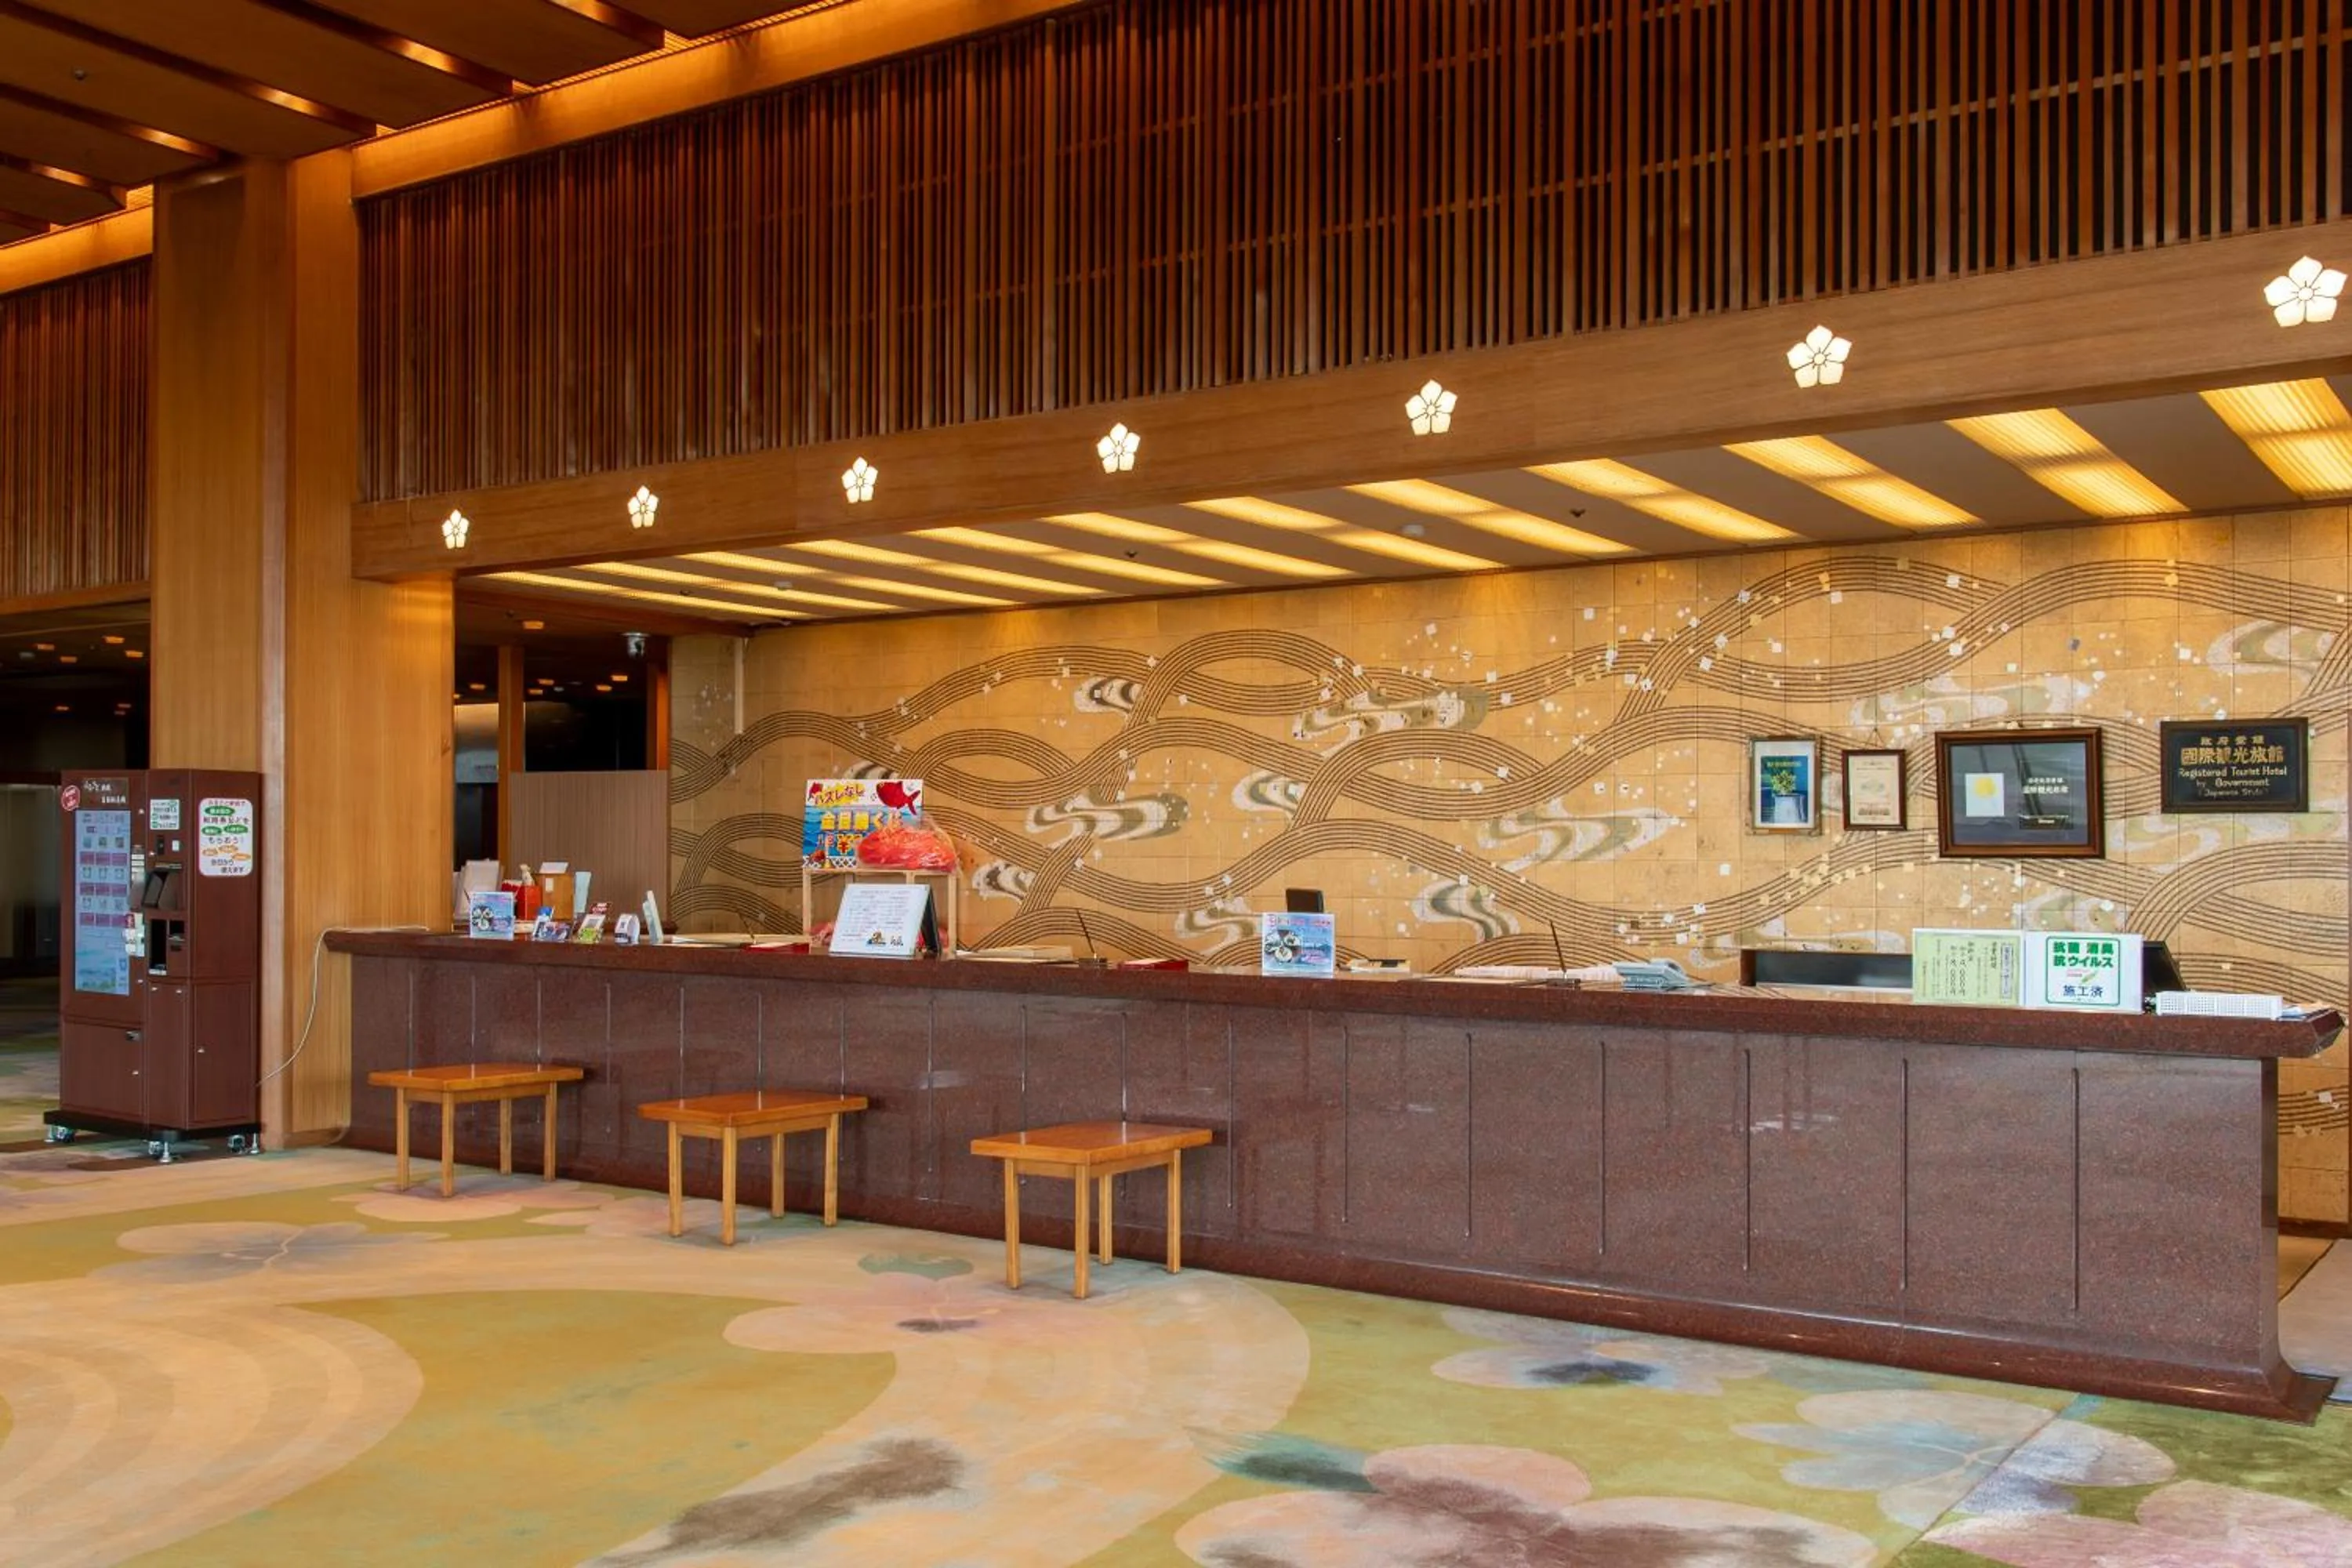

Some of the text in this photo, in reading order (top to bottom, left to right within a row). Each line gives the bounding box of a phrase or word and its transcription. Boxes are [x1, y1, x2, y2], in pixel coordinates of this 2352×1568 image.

[2179, 765, 2287, 779] Registered Tourist Hotel
[2215, 778, 2270, 787] Government
[2053, 955, 2114, 967] 抗ウイルス
[2063, 984, 2103, 997] 施工済
